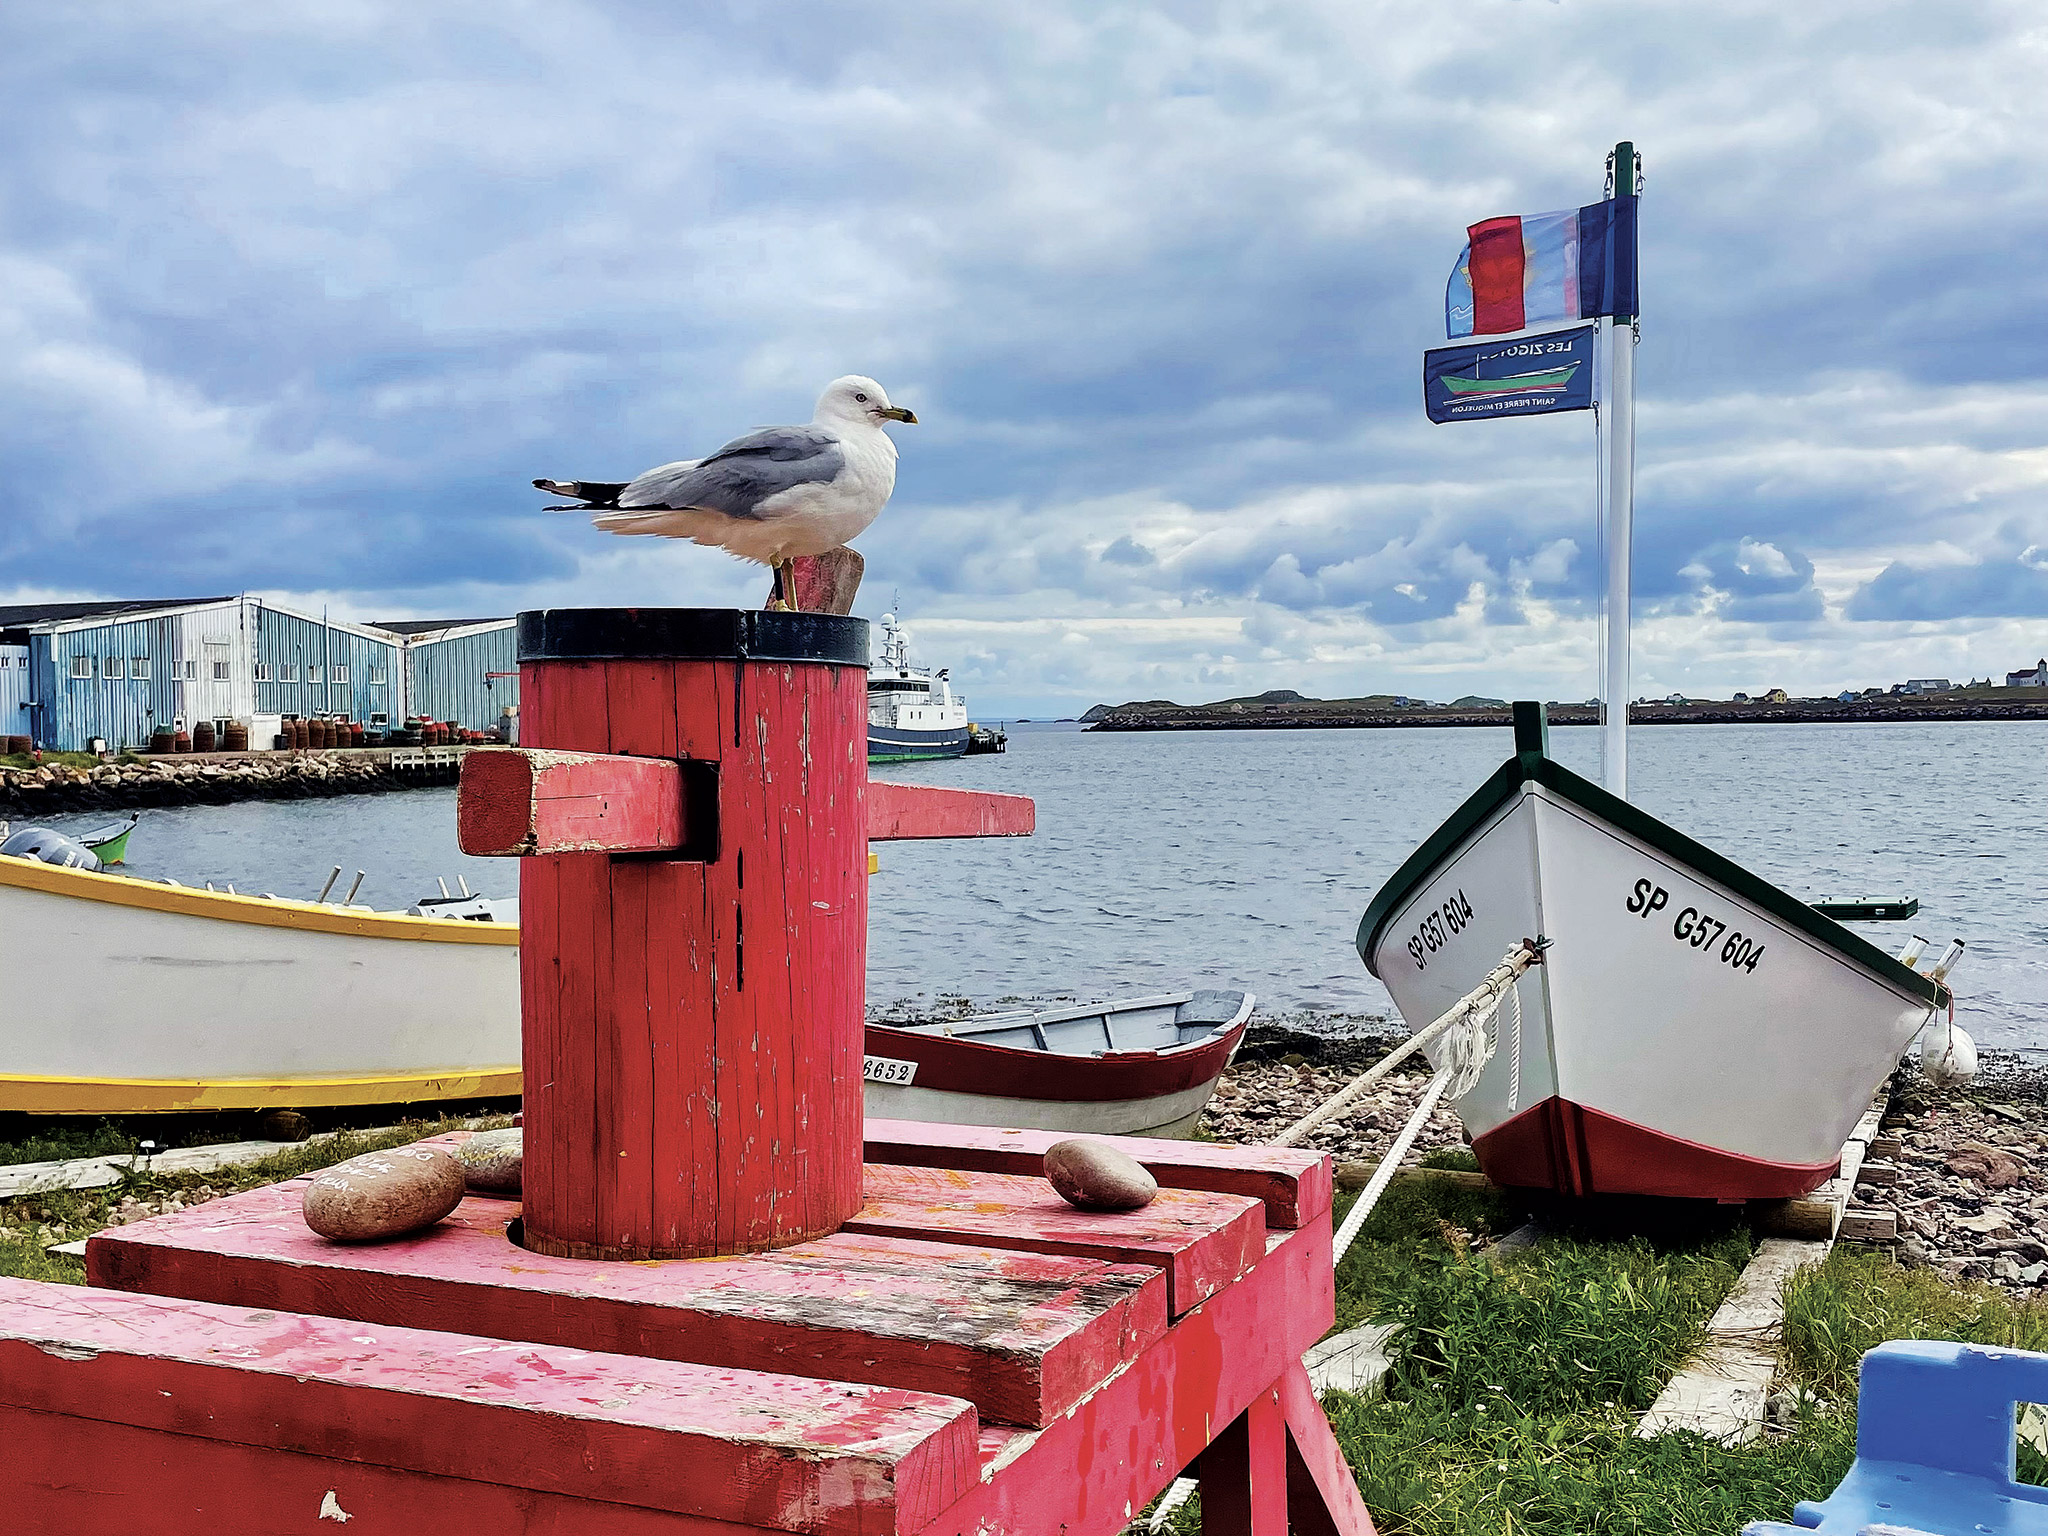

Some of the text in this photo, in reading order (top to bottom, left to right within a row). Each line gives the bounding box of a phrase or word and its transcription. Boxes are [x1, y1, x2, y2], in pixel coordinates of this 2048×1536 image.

[1407, 888, 1474, 970] SP G57 604
[1626, 877, 1766, 975] SP G57 604
